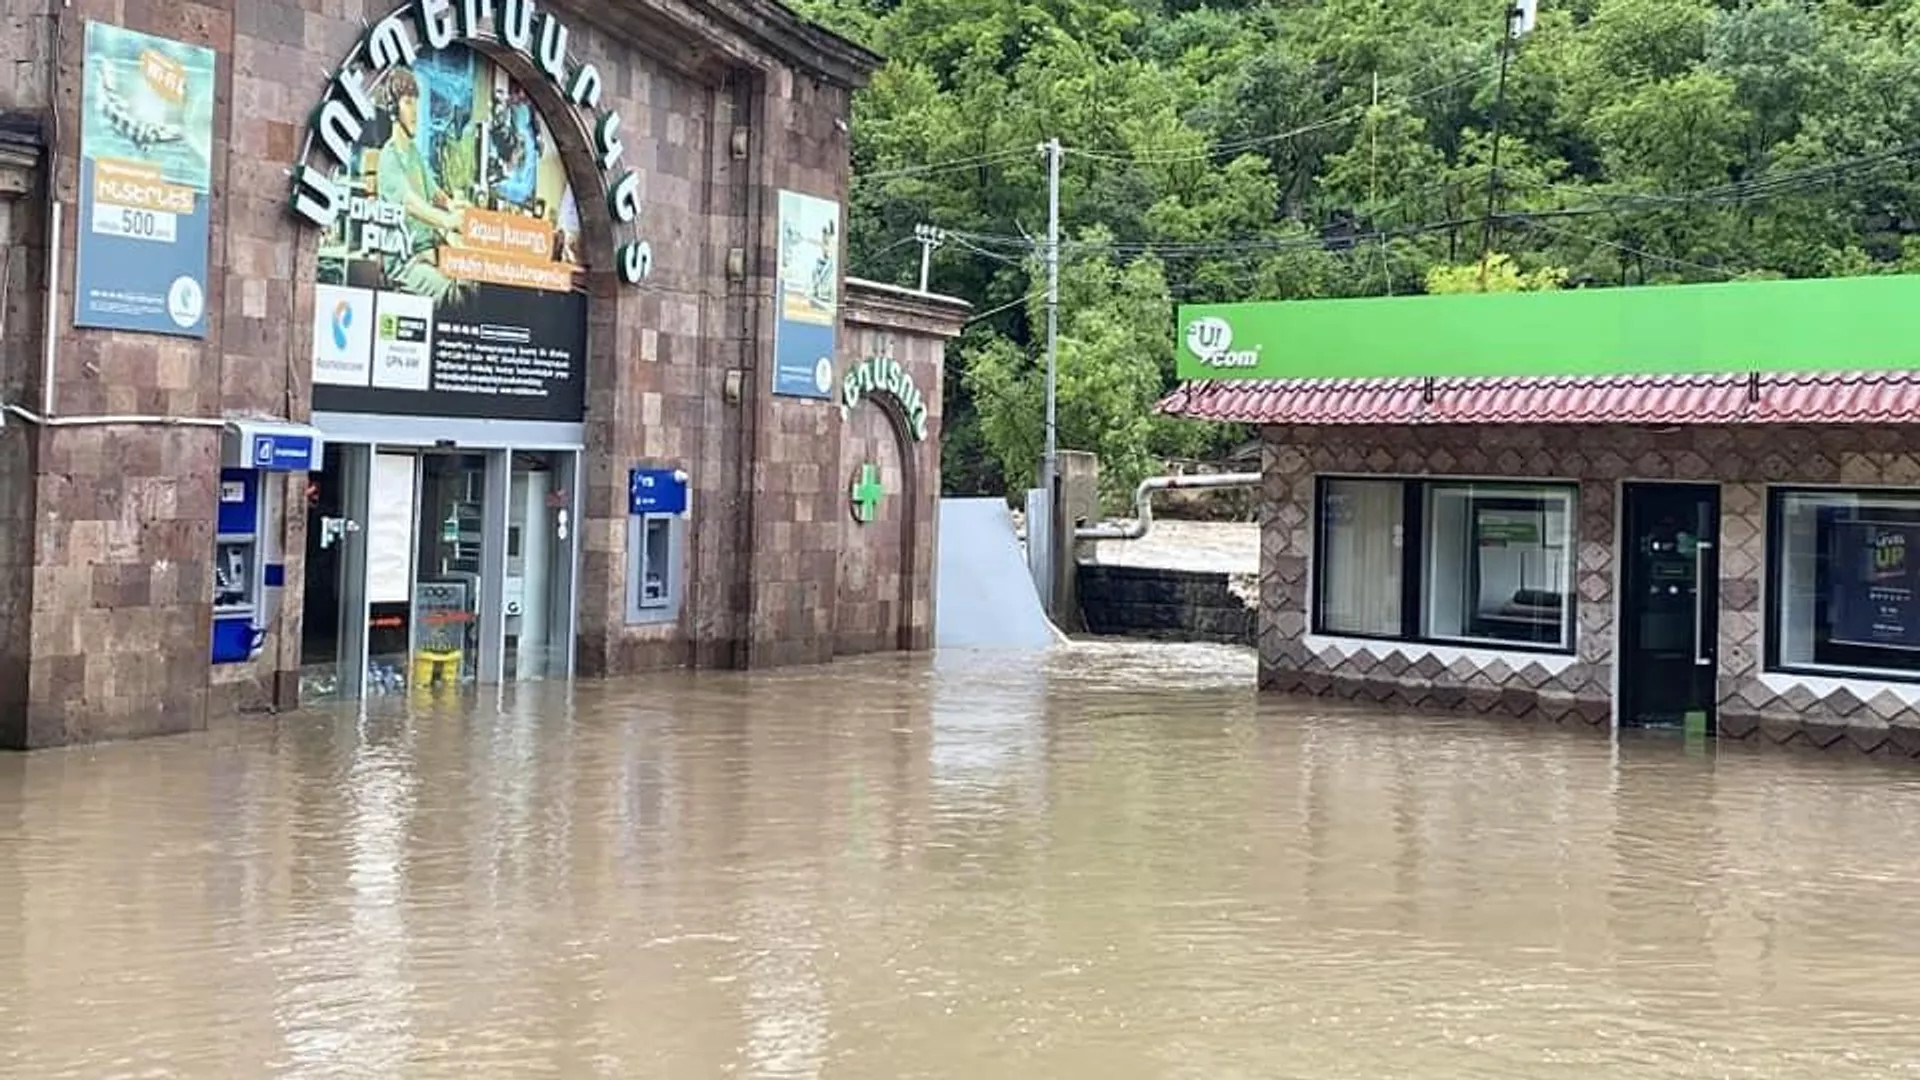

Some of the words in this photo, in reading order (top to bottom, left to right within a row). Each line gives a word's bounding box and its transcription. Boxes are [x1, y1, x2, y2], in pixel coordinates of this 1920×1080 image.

[122, 208, 155, 236] 500
[361, 223, 419, 261] PLAY
[1212, 351, 1259, 368] com
[1876, 546, 1904, 568] UP
